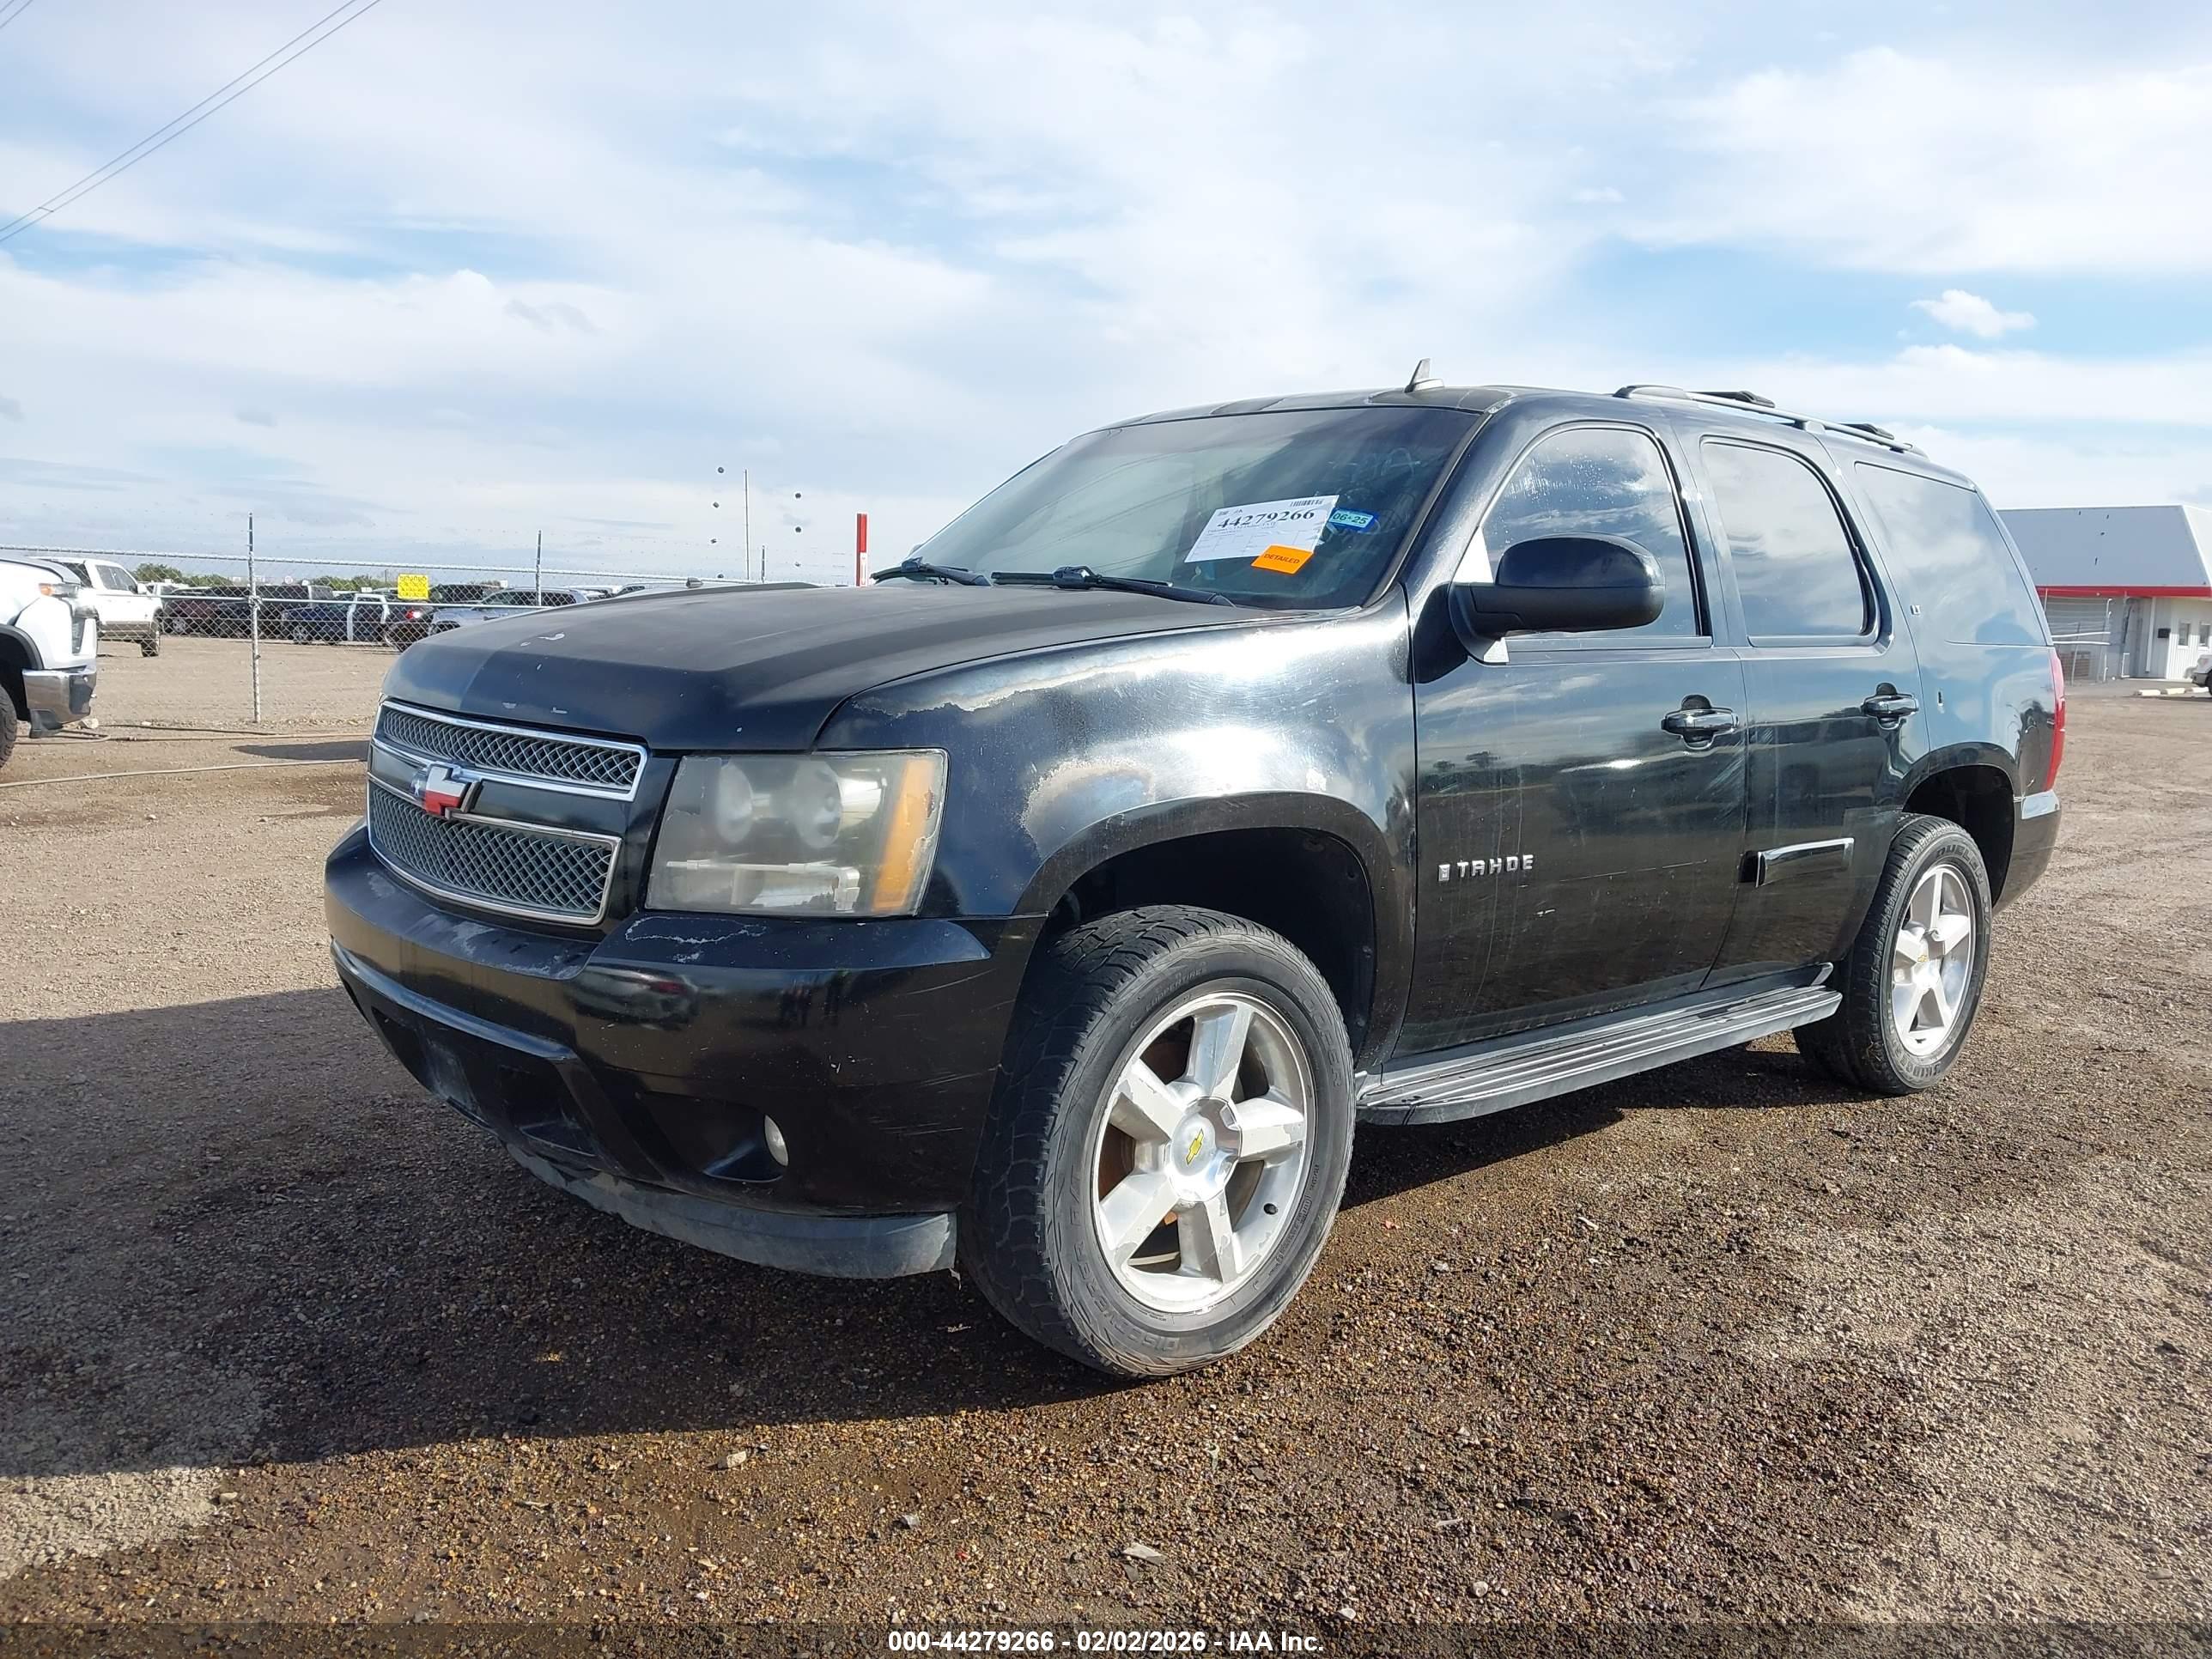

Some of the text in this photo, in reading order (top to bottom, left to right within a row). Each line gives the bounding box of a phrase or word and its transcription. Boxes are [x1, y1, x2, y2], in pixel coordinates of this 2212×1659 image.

[1217, 508, 1319, 529] 44279266
[1333, 513, 1369, 525] 06 25
[1263, 553, 1301, 564] DETAILED
[1456, 854, 1534, 878] TAHOE
[1291, 986, 1342, 1087] COOPER
